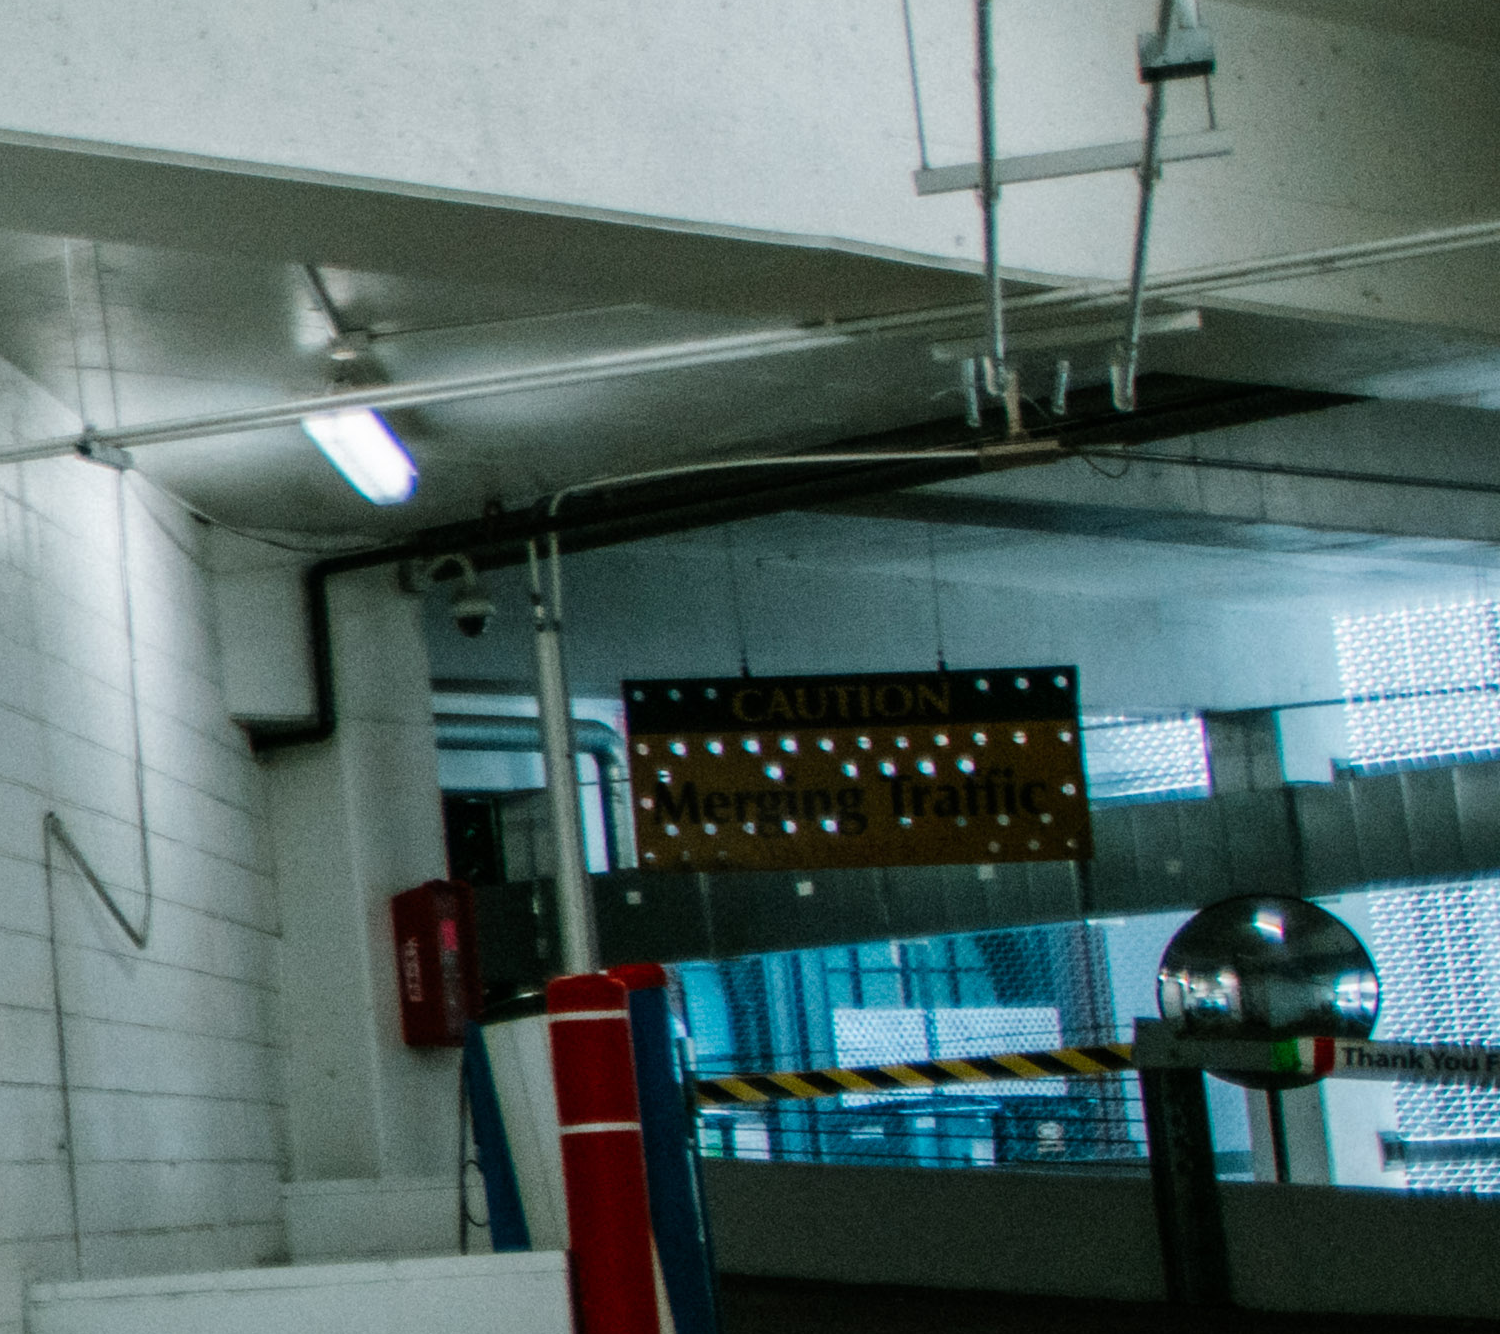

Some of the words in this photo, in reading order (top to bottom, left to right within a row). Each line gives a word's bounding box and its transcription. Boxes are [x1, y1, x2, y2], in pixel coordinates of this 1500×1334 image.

[732, 681, 951, 723] CAUTION
[653, 775, 869, 840] Merging
[879, 768, 1049, 820] Traffic
[1342, 1046, 1424, 1071] Thank
[1429, 1050, 1479, 1073] You
